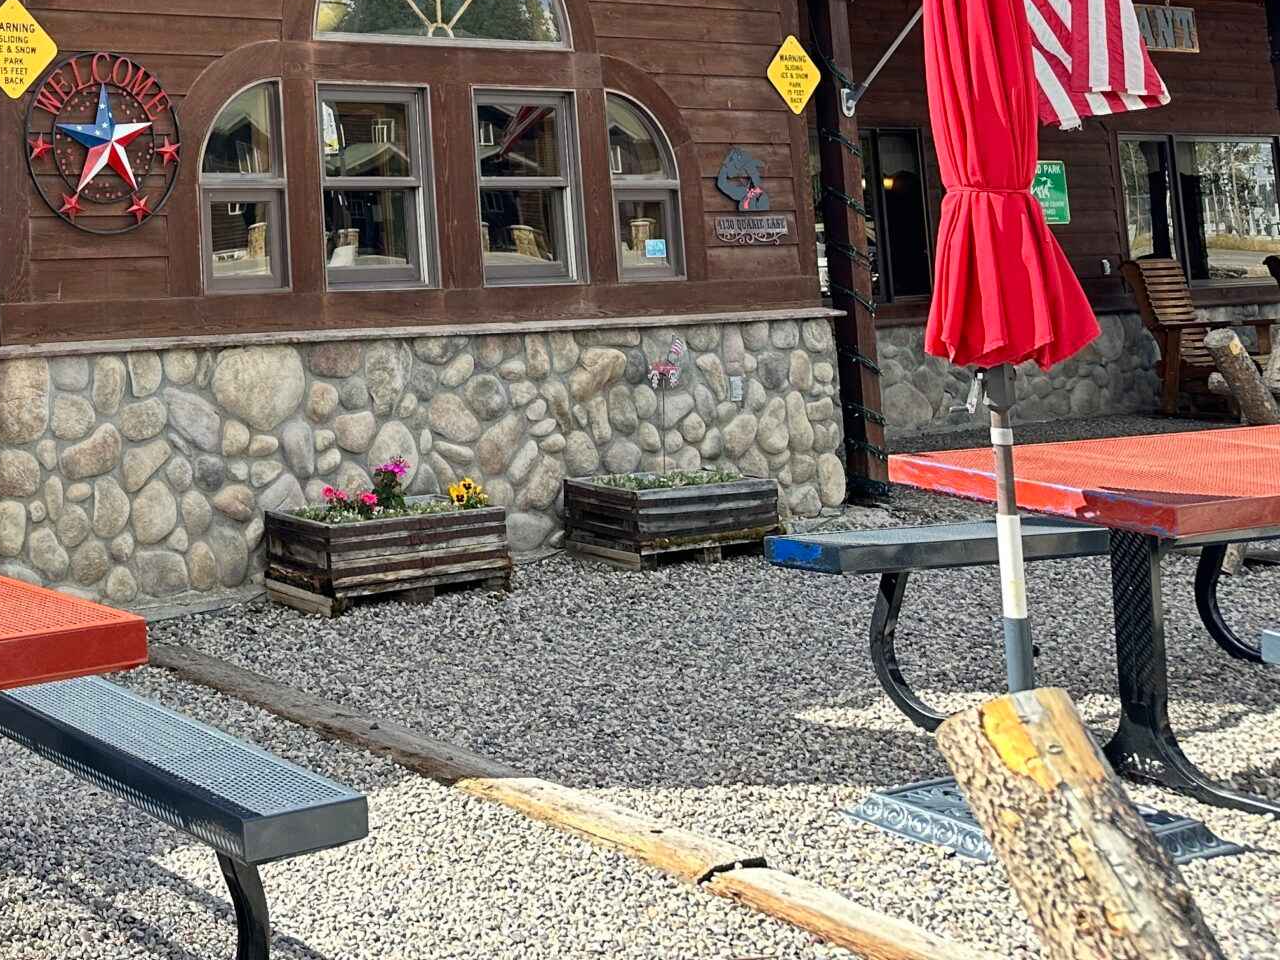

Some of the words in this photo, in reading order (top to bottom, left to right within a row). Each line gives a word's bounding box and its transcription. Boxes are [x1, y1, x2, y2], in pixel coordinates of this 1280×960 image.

[0, 35, 28, 44] SLIDING
[7, 45, 12, 53] &
[16, 46, 36, 54] SNOW
[4, 57, 23, 65] PARK
[780, 54, 807, 63] WARNING
[5, 77, 24, 85] BACK
[33, 52, 170, 121] WELCOME
[1044, 164, 1061, 174] PARK
